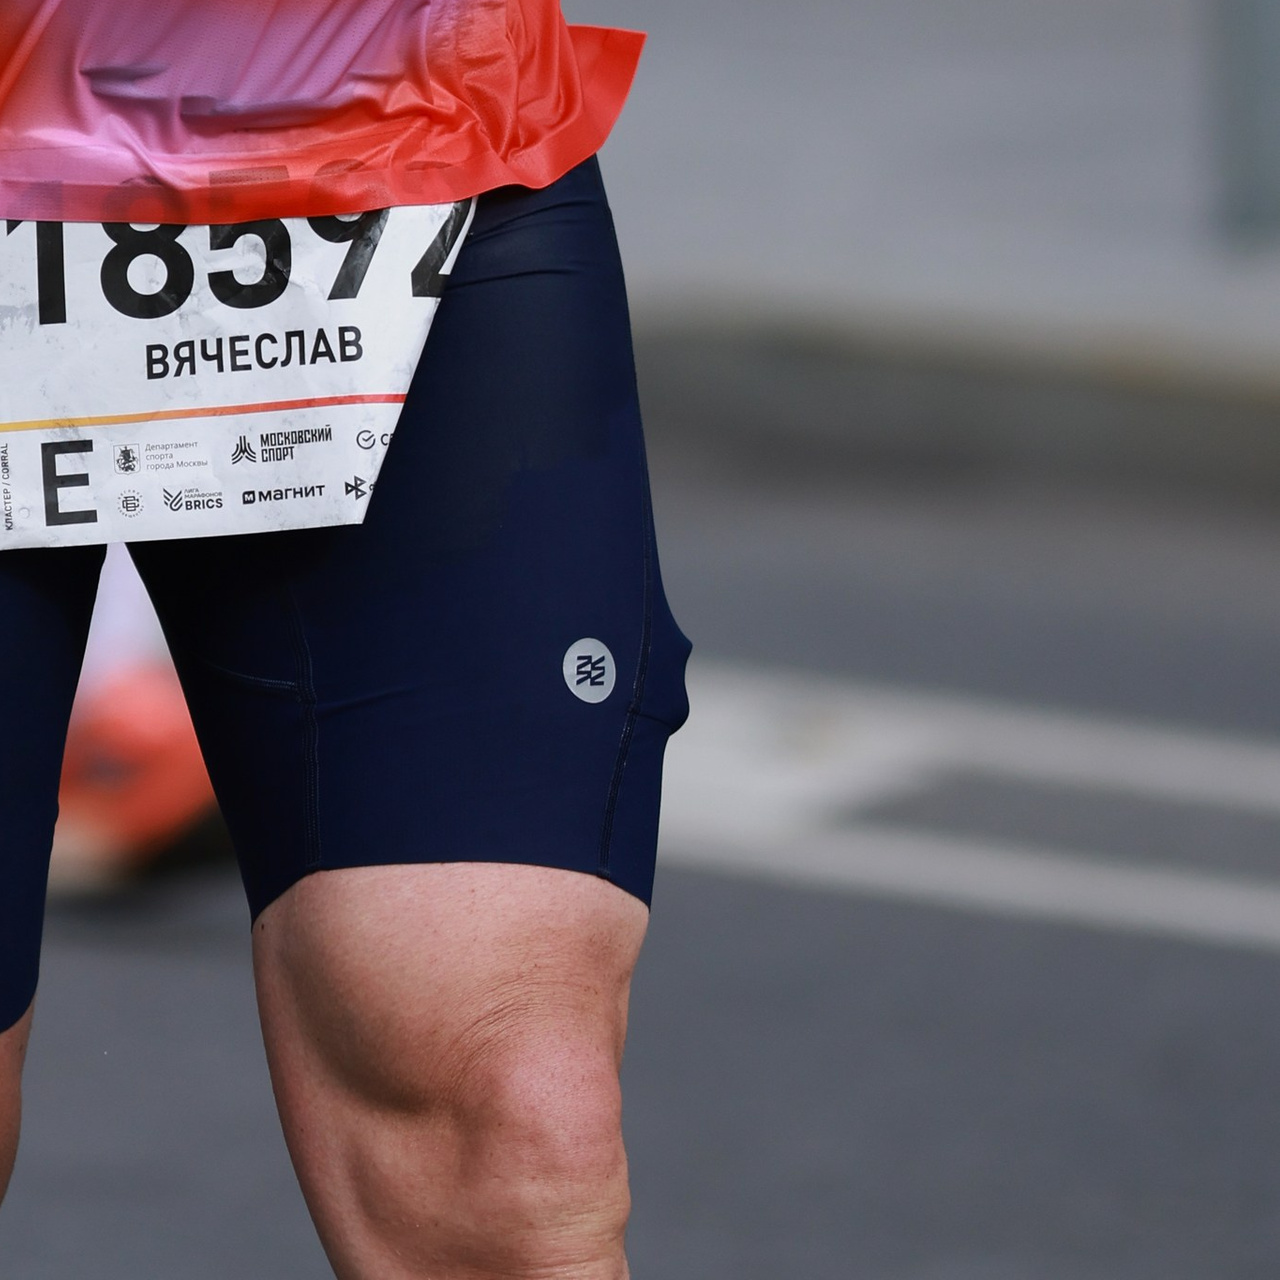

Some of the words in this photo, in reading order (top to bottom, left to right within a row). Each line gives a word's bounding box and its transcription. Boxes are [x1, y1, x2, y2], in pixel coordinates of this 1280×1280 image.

[145, 326, 364, 380] ВЯЧЕСЛАВ
[260, 425, 332, 447] МОСКОВСКИЙ
[145, 441, 198, 452] Департамент
[0, 443, 9, 480] CORRAL
[145, 453, 174, 461] спорта
[261, 446, 295, 463] СПОРТ
[146, 462, 175, 471] города
[176, 460, 208, 468] Москвы
[184, 491, 223, 499] МАРАФОНОВ
[3, 488, 14, 531] КЛАСТЕР
[185, 498, 223, 511] BRICS
